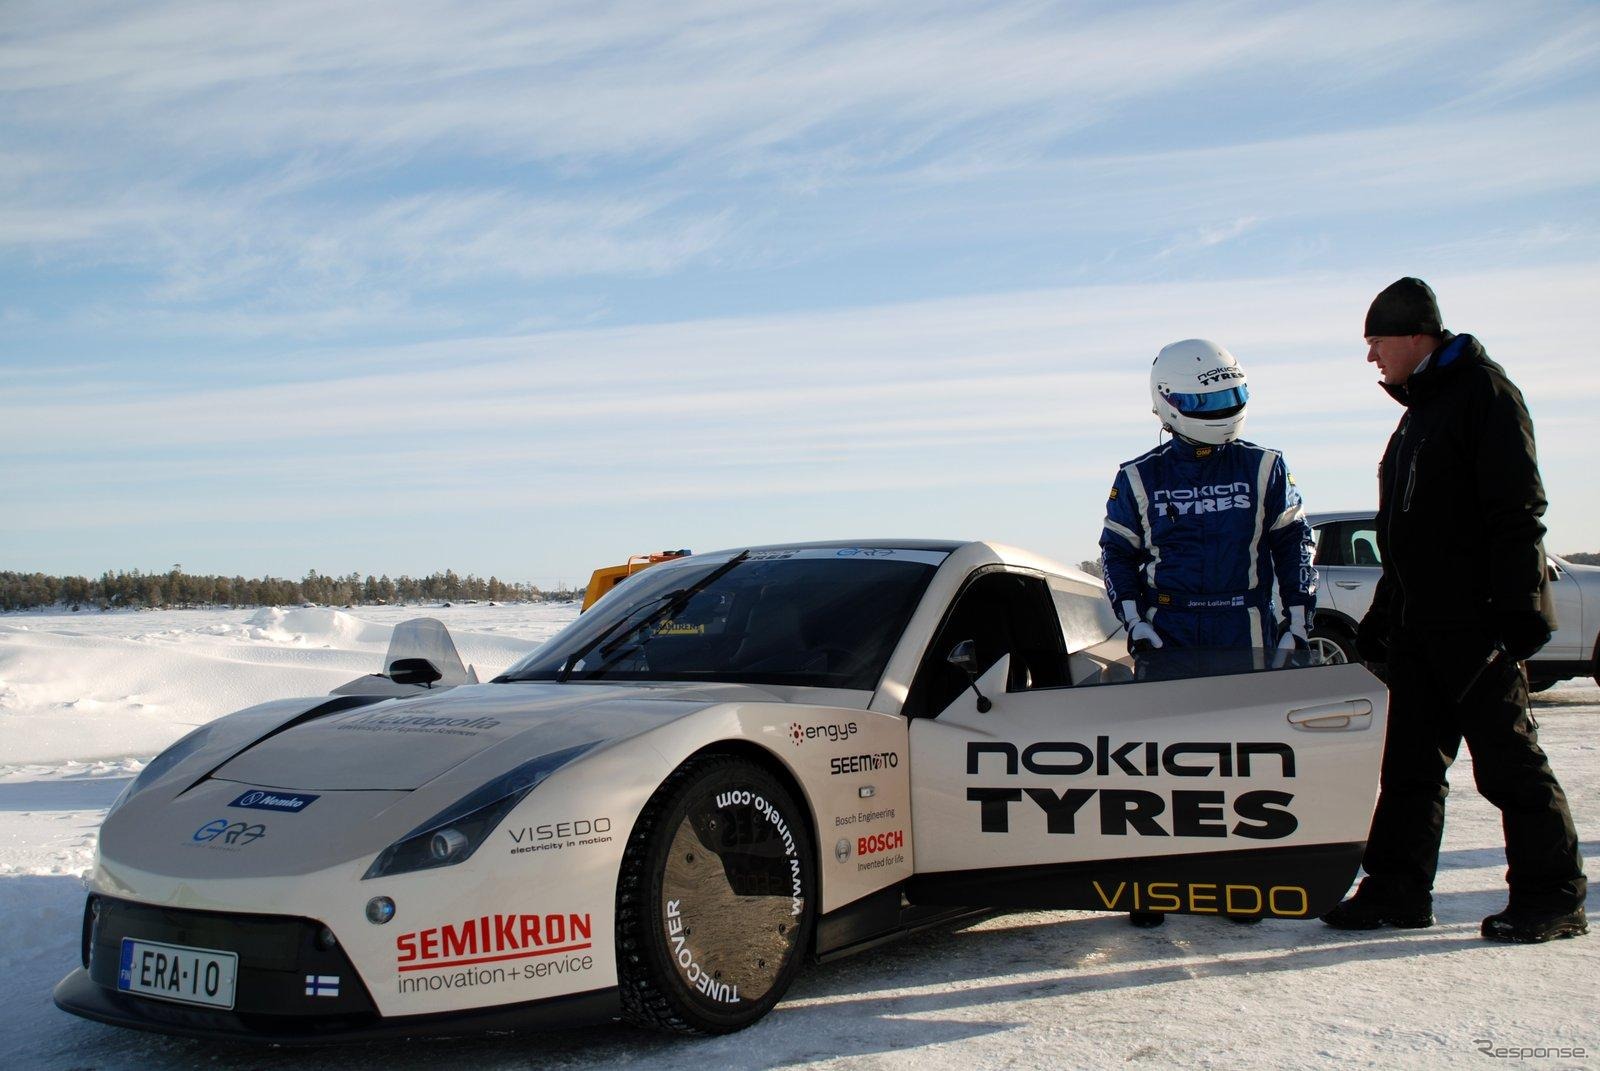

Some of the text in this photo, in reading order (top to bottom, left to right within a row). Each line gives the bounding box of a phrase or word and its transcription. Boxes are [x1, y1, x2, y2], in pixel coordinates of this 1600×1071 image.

[1200, 372, 1245, 386] TYRES
[1153, 481, 1250, 500] nokian
[1153, 494, 1251, 517] TYRES
[805, 722, 858, 742] engys
[966, 735, 1297, 778] nokian
[259, 795, 304, 808] Nemko
[966, 787, 1299, 840] TYRES
[835, 807, 896, 827] Bosch Engineering
[508, 817, 612, 844] VISEDO
[510, 836, 613, 855] electricity in motion
[715, 790, 802, 917] www.tuneko.com
[857, 830, 904, 856] BOSCH
[857, 853, 904, 872] Invented for life
[1092, 880, 1309, 916] VISEDO
[396, 913, 592, 962] SEMIKRON
[666, 899, 741, 1003] TUNECOVER
